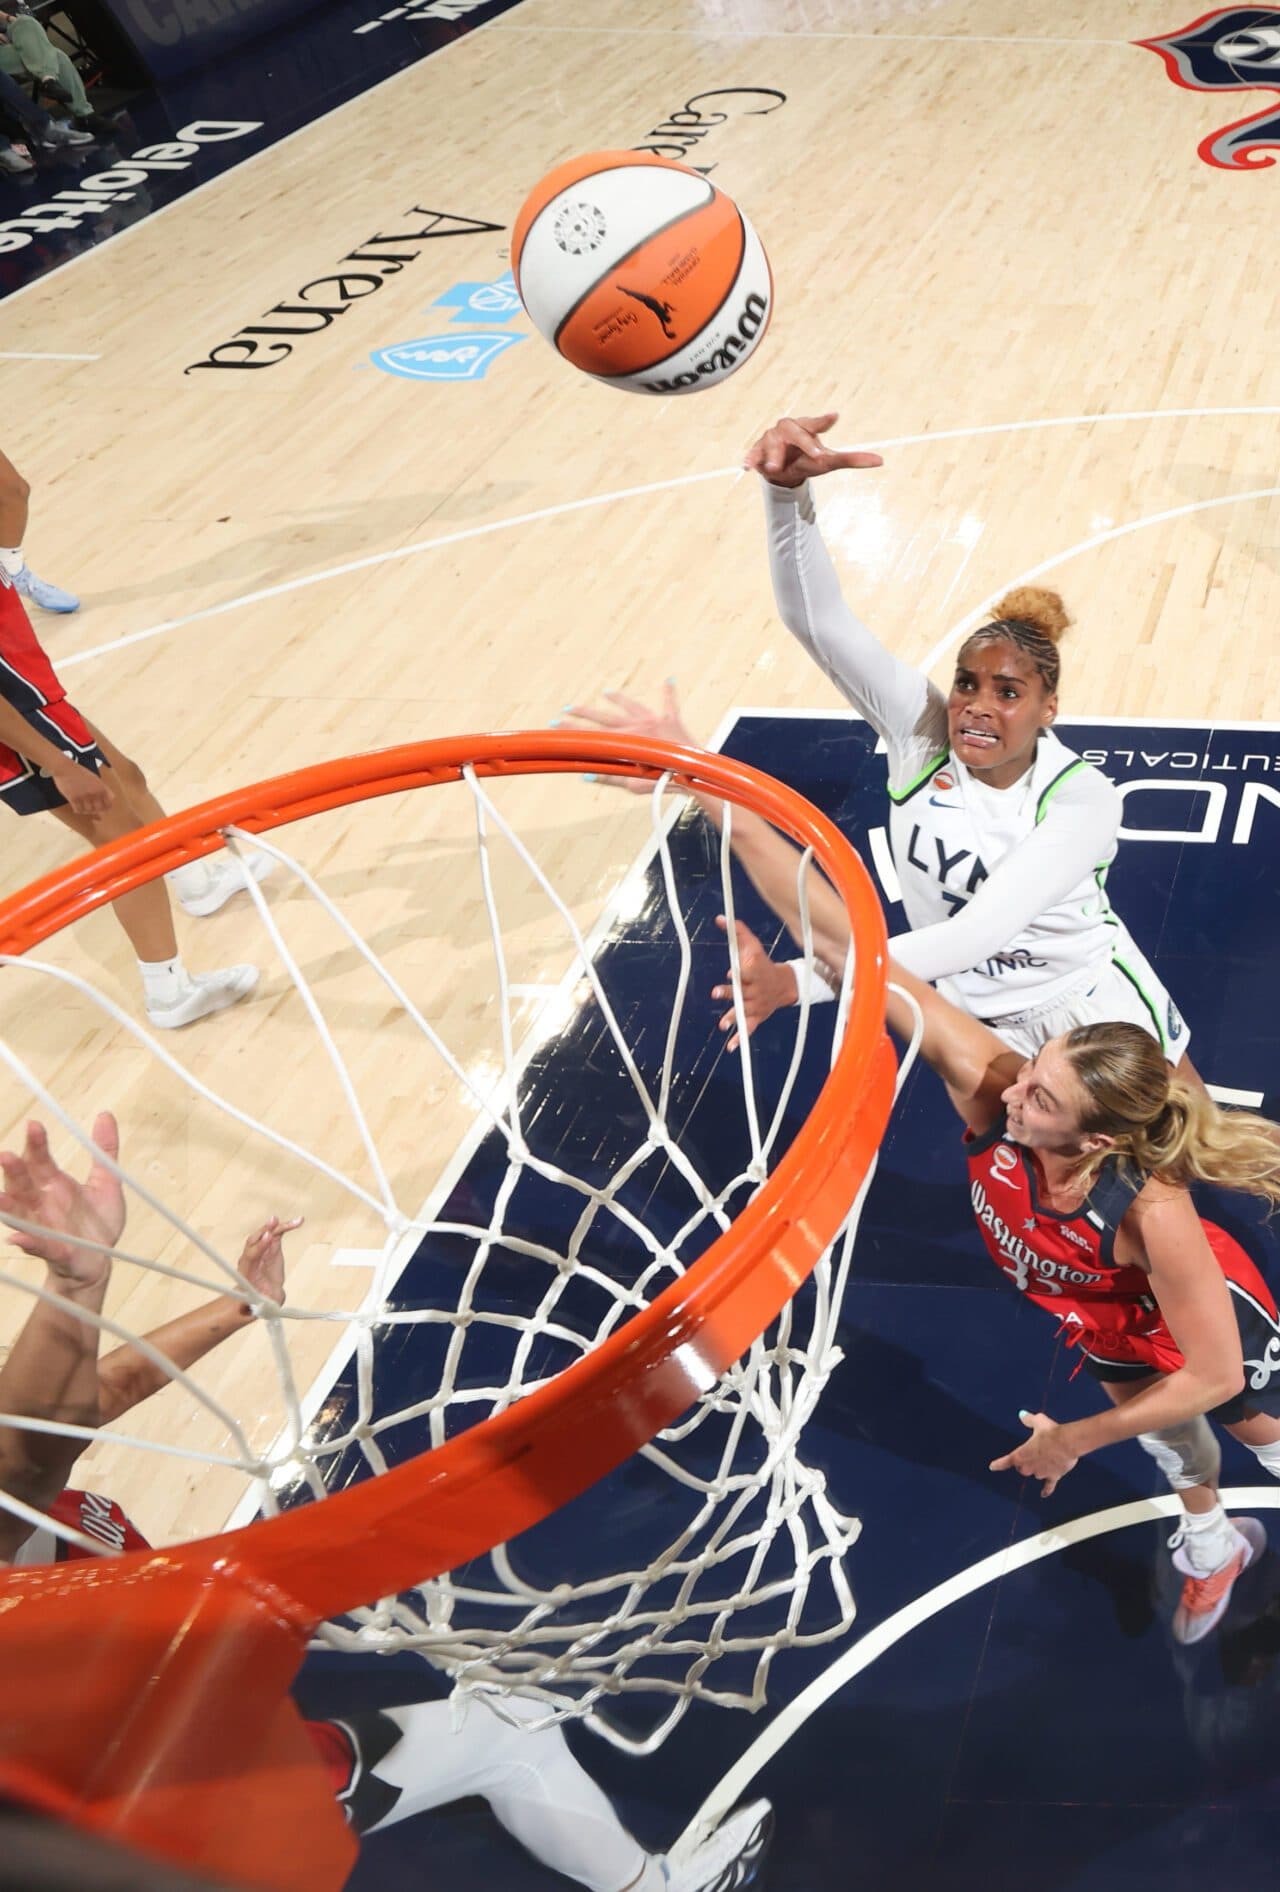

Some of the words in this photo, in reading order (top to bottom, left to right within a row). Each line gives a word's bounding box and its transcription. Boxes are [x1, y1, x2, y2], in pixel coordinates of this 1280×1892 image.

[184, 204, 507, 375] Arena
[637, 292, 767, 393] Wilson
[907, 824, 990, 893] LYN
